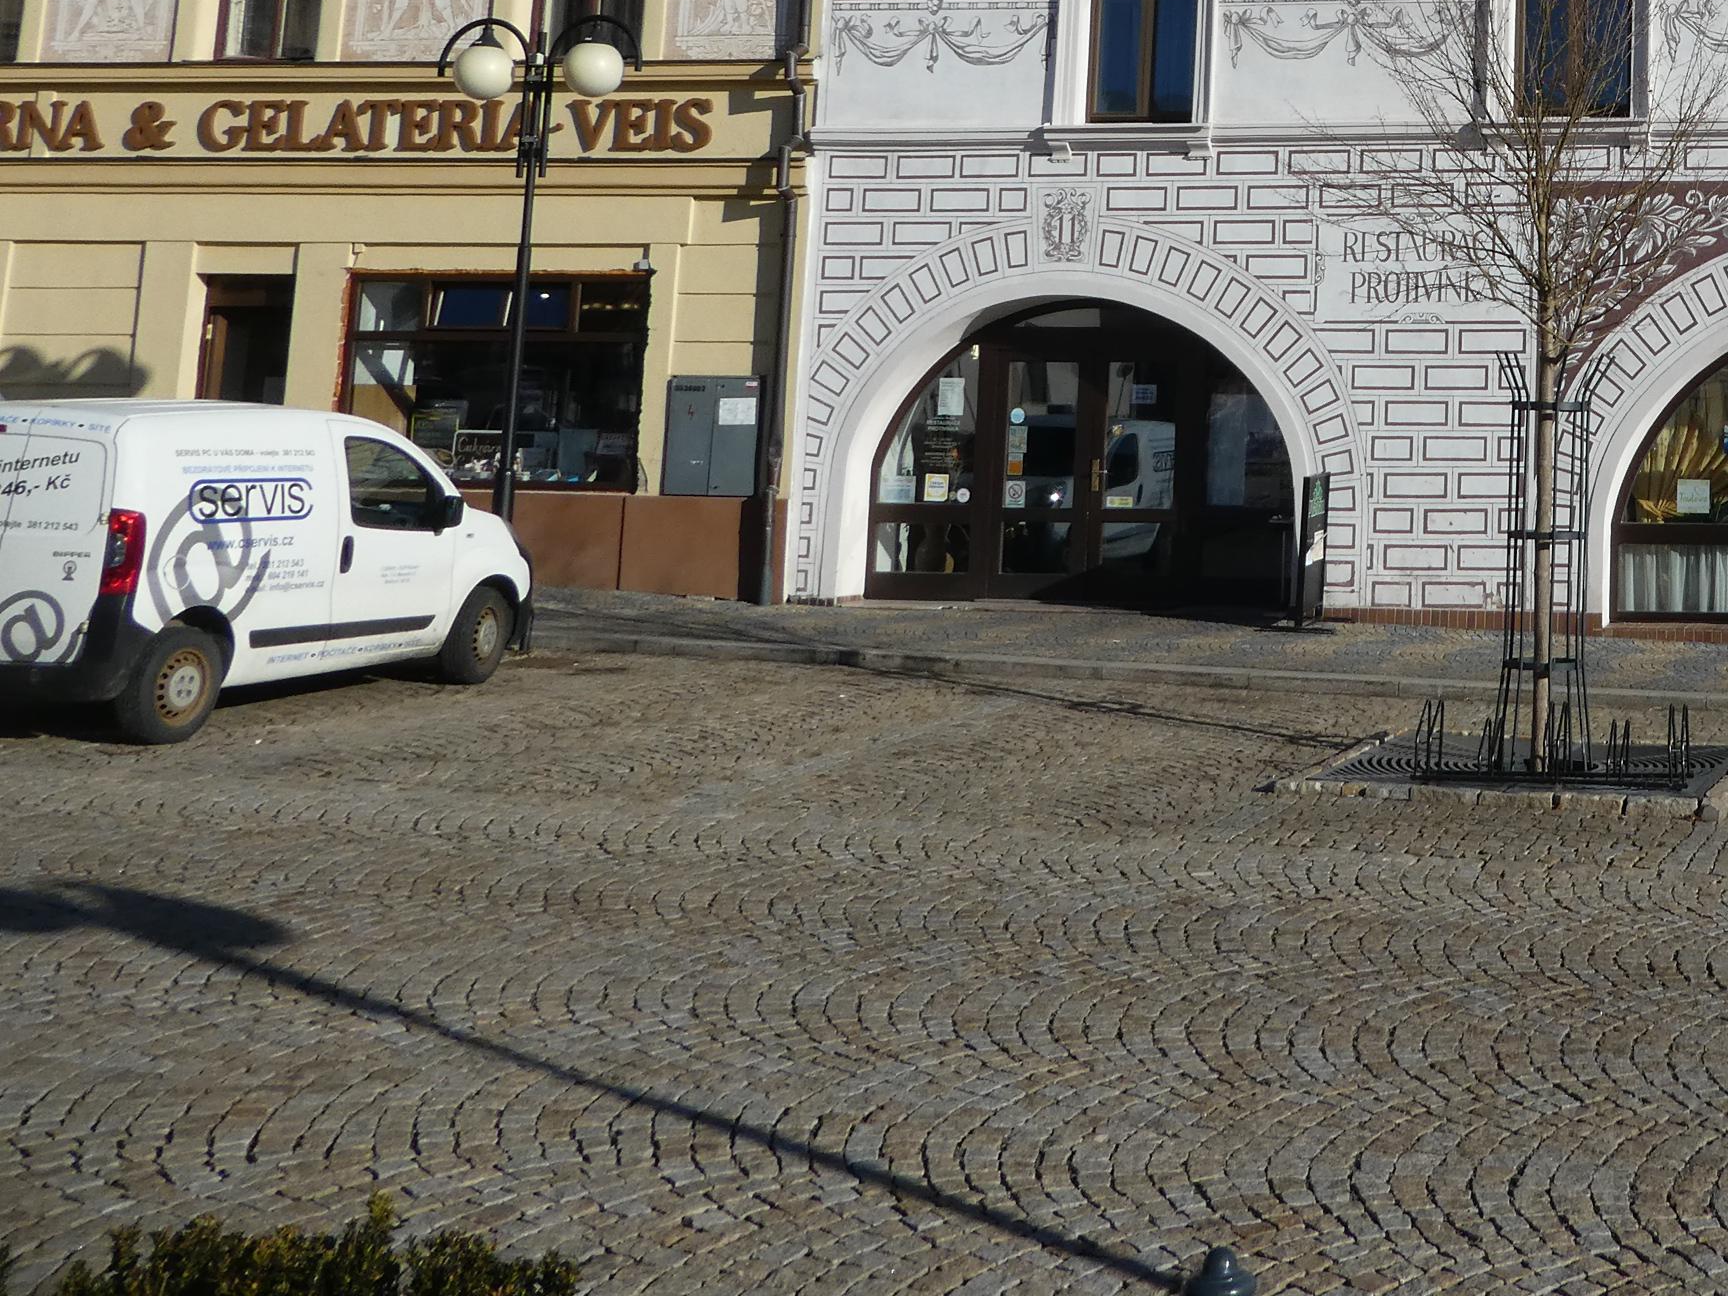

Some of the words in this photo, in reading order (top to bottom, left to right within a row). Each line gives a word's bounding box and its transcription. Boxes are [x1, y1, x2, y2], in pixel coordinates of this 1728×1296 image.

[122, 101, 177, 151] &
[565, 98, 714, 152] VEIS
[1057, 213, 1076, 246] 11
[1343, 230, 1506, 263] RESTAURACE
[45, 473, 72, 491] Kč
[199, 483, 305, 518] servis
